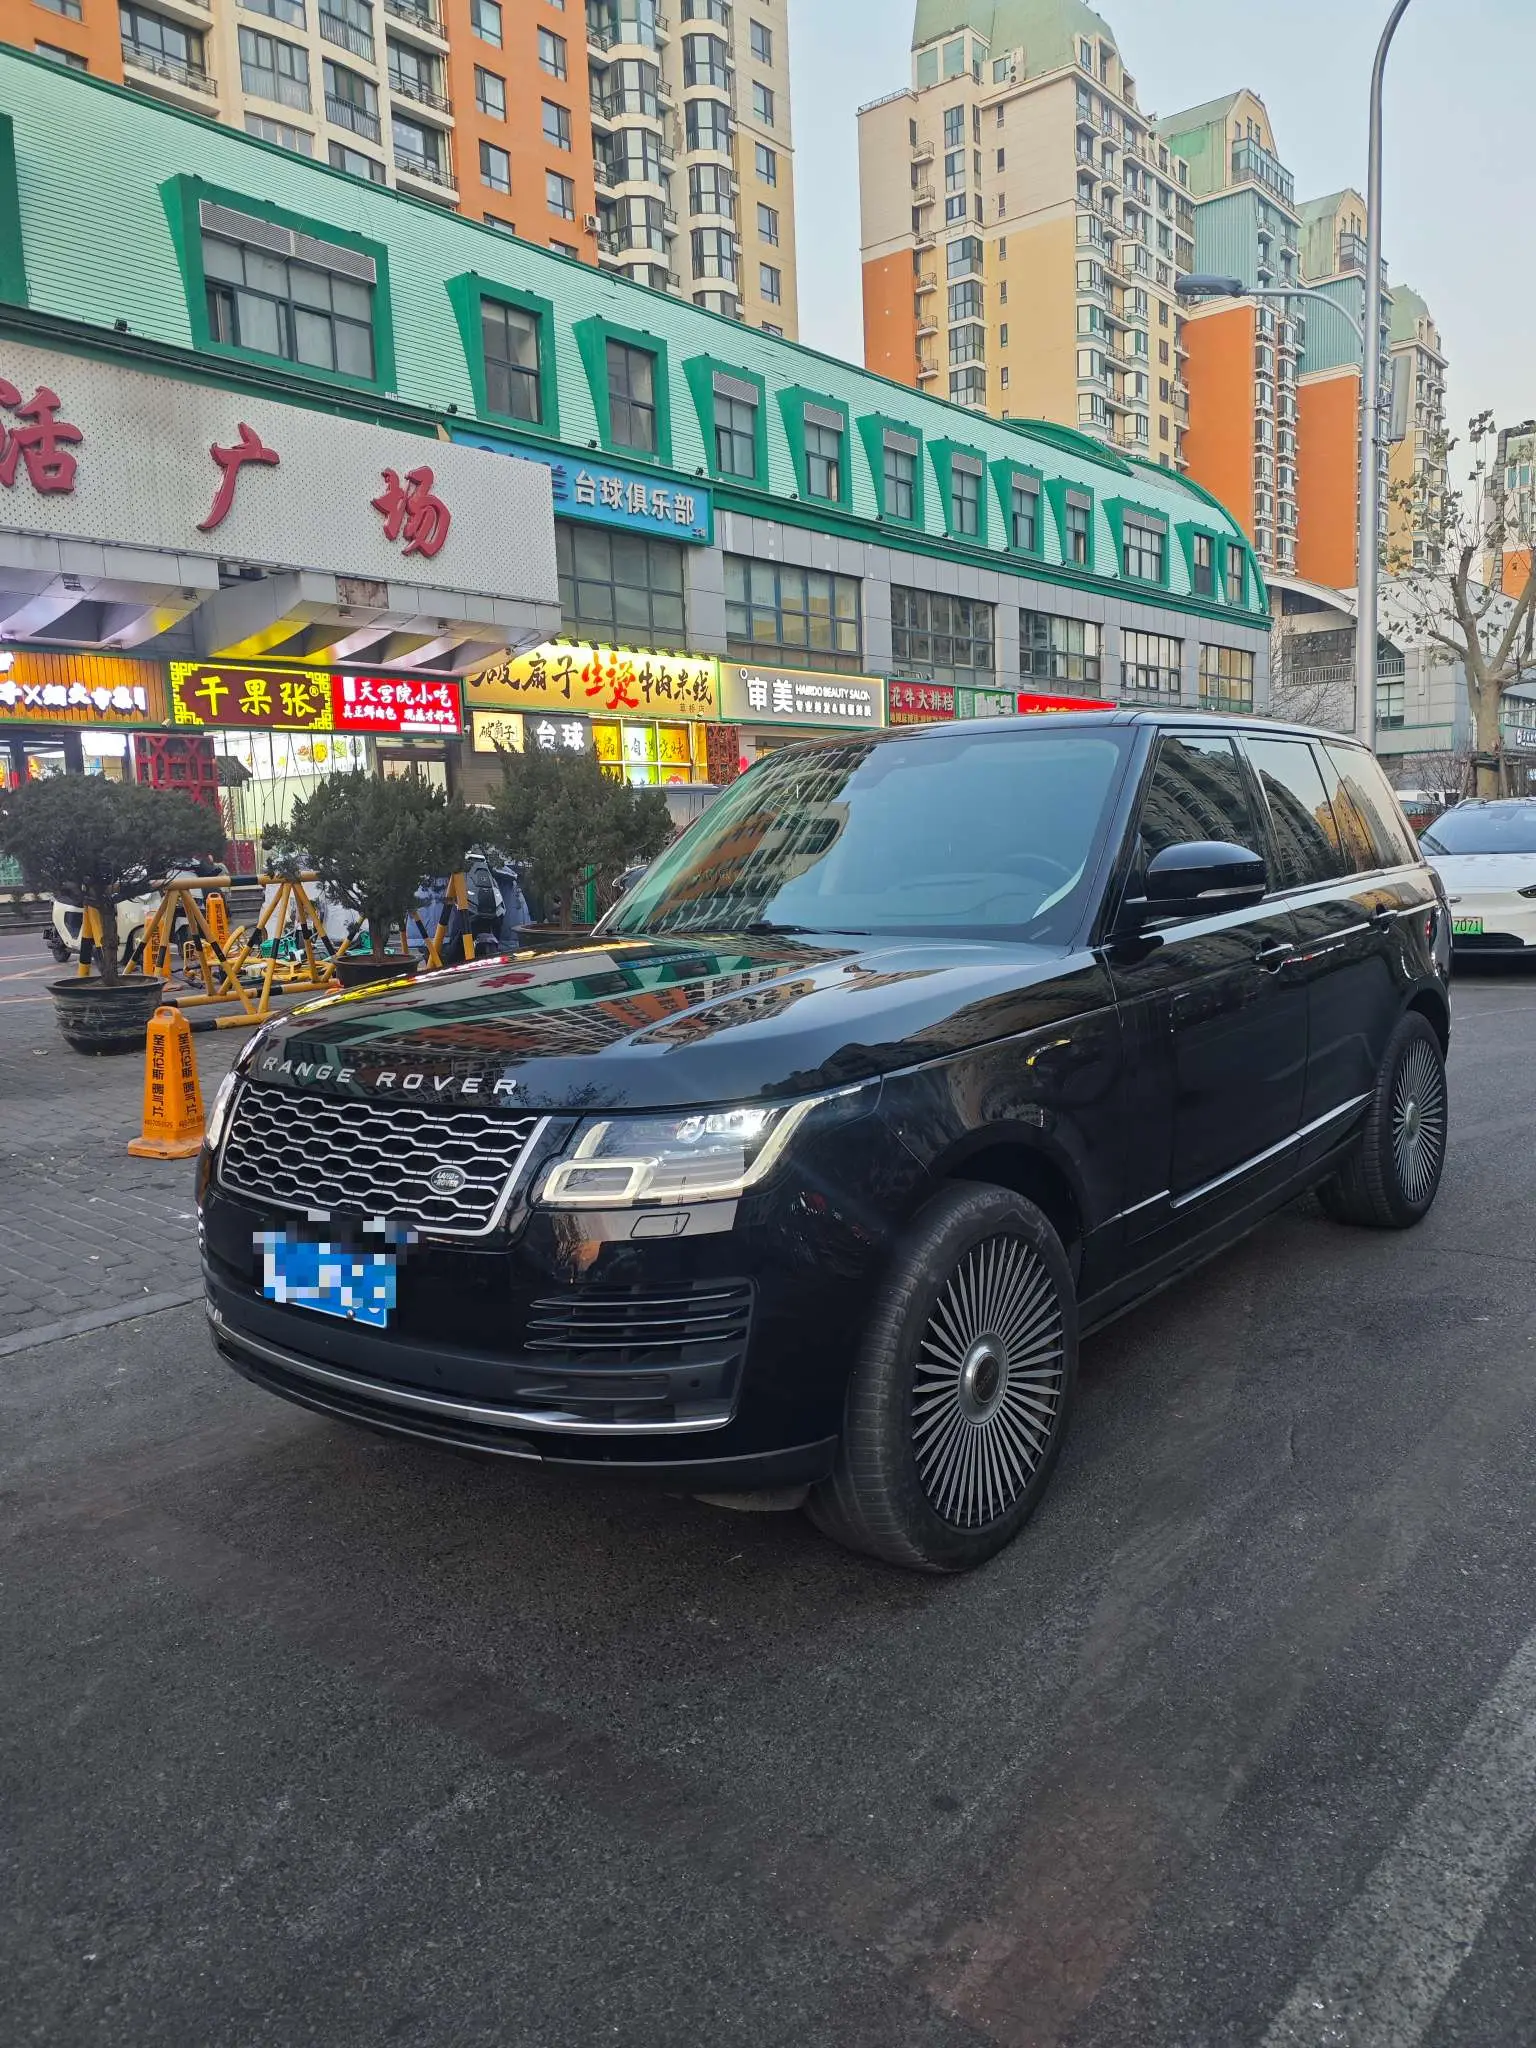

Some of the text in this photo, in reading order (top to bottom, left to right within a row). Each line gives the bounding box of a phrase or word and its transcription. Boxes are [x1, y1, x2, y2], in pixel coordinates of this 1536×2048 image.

[575, 469, 695, 526] 台球俱乐部
[359, 681, 452, 708] 天宫院小吃
[747, 677, 794, 713] 审美
[823, 686, 848, 698] BEAUTY
[536, 720, 585, 751] 台球
[1453, 919, 1479, 932] 7071
[262, 1057, 518, 1095] RANGE ROVER
[436, 1179, 459, 1187] ROVER
